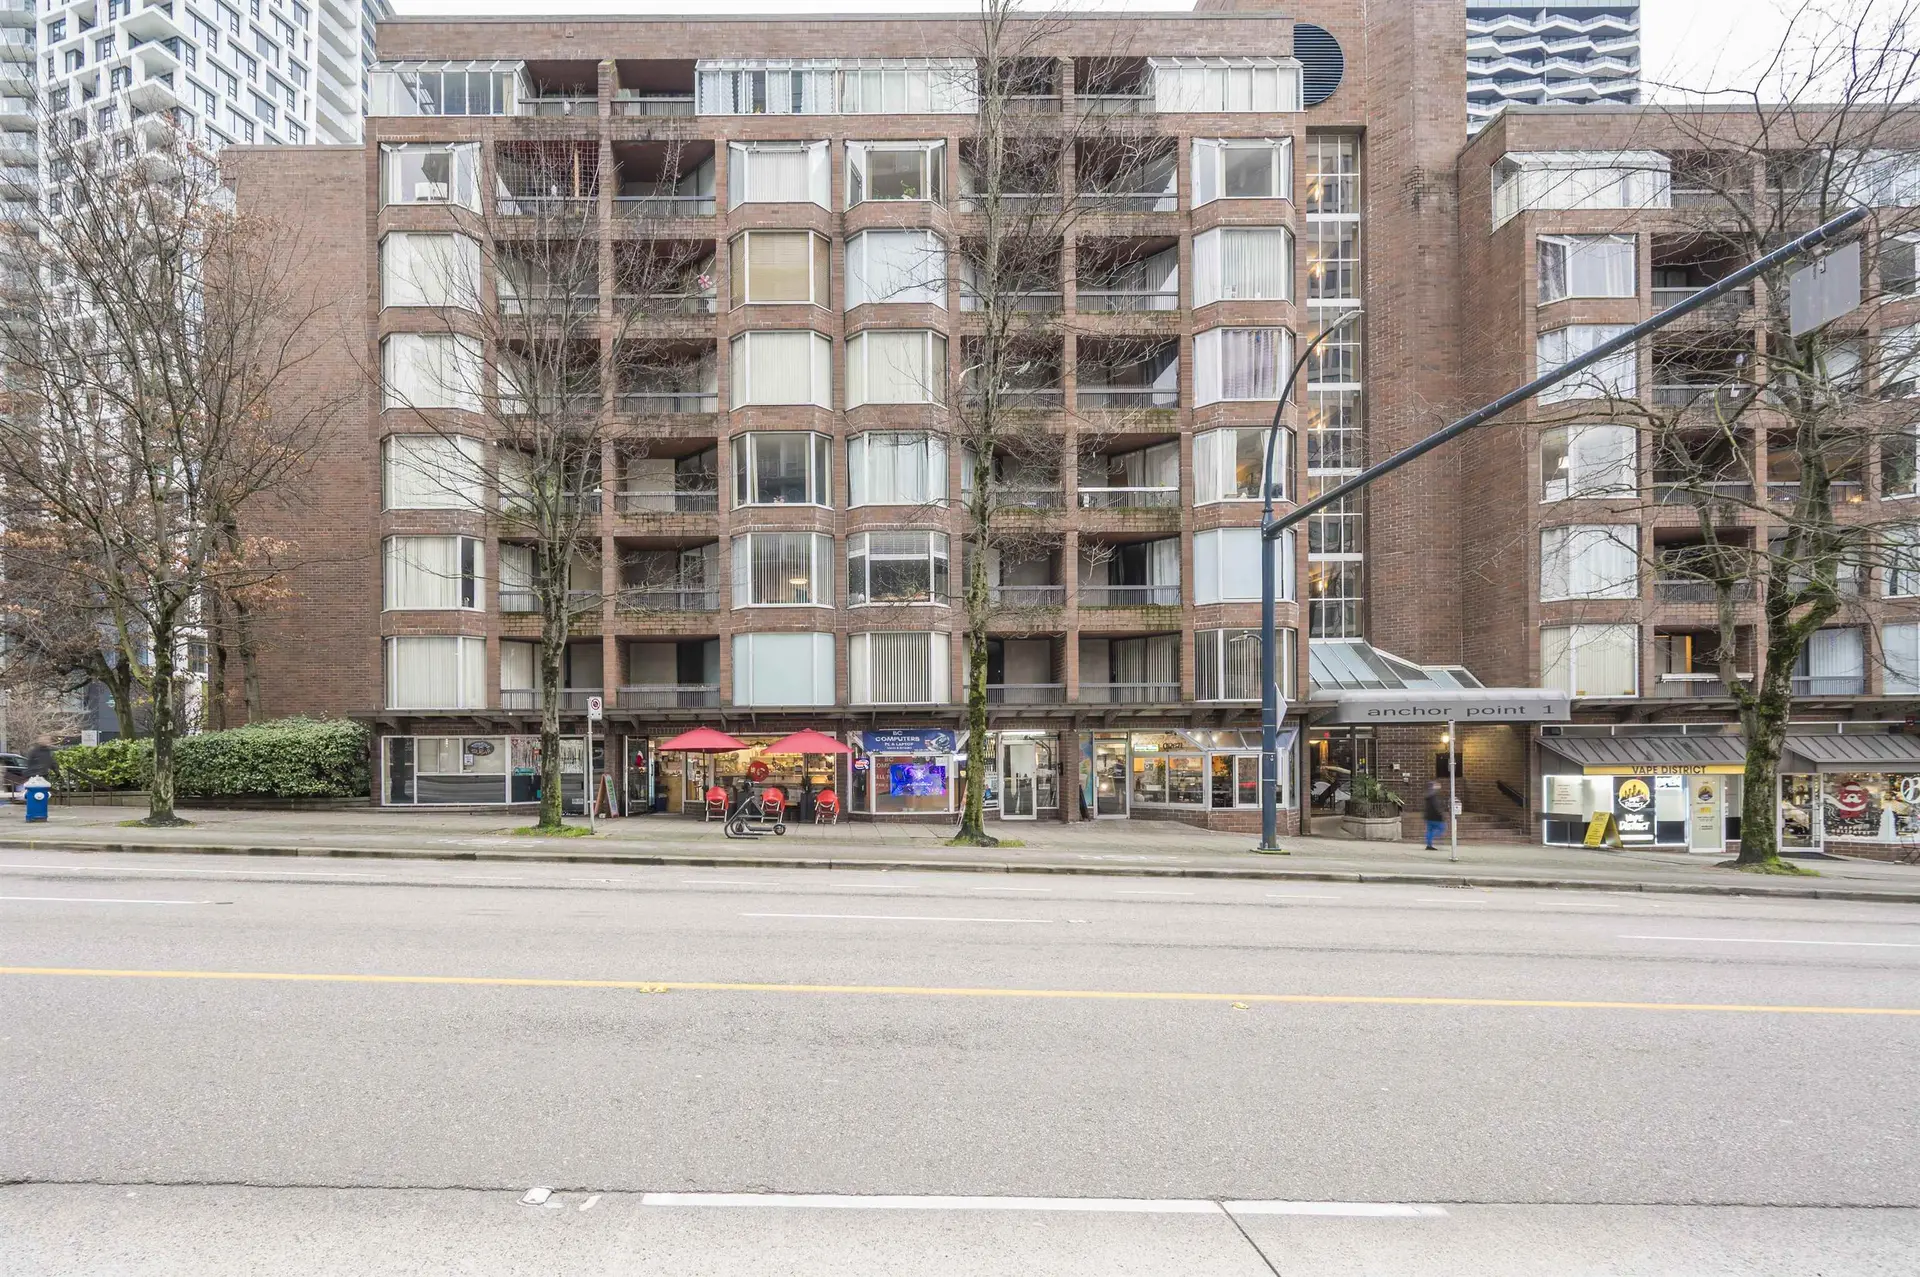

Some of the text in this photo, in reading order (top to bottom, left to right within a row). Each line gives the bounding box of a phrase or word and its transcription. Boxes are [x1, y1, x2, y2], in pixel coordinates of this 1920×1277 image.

[1367, 705, 1555, 717] anchor point 1
[1631, 765, 1707, 774] VAPE DISTRICT
